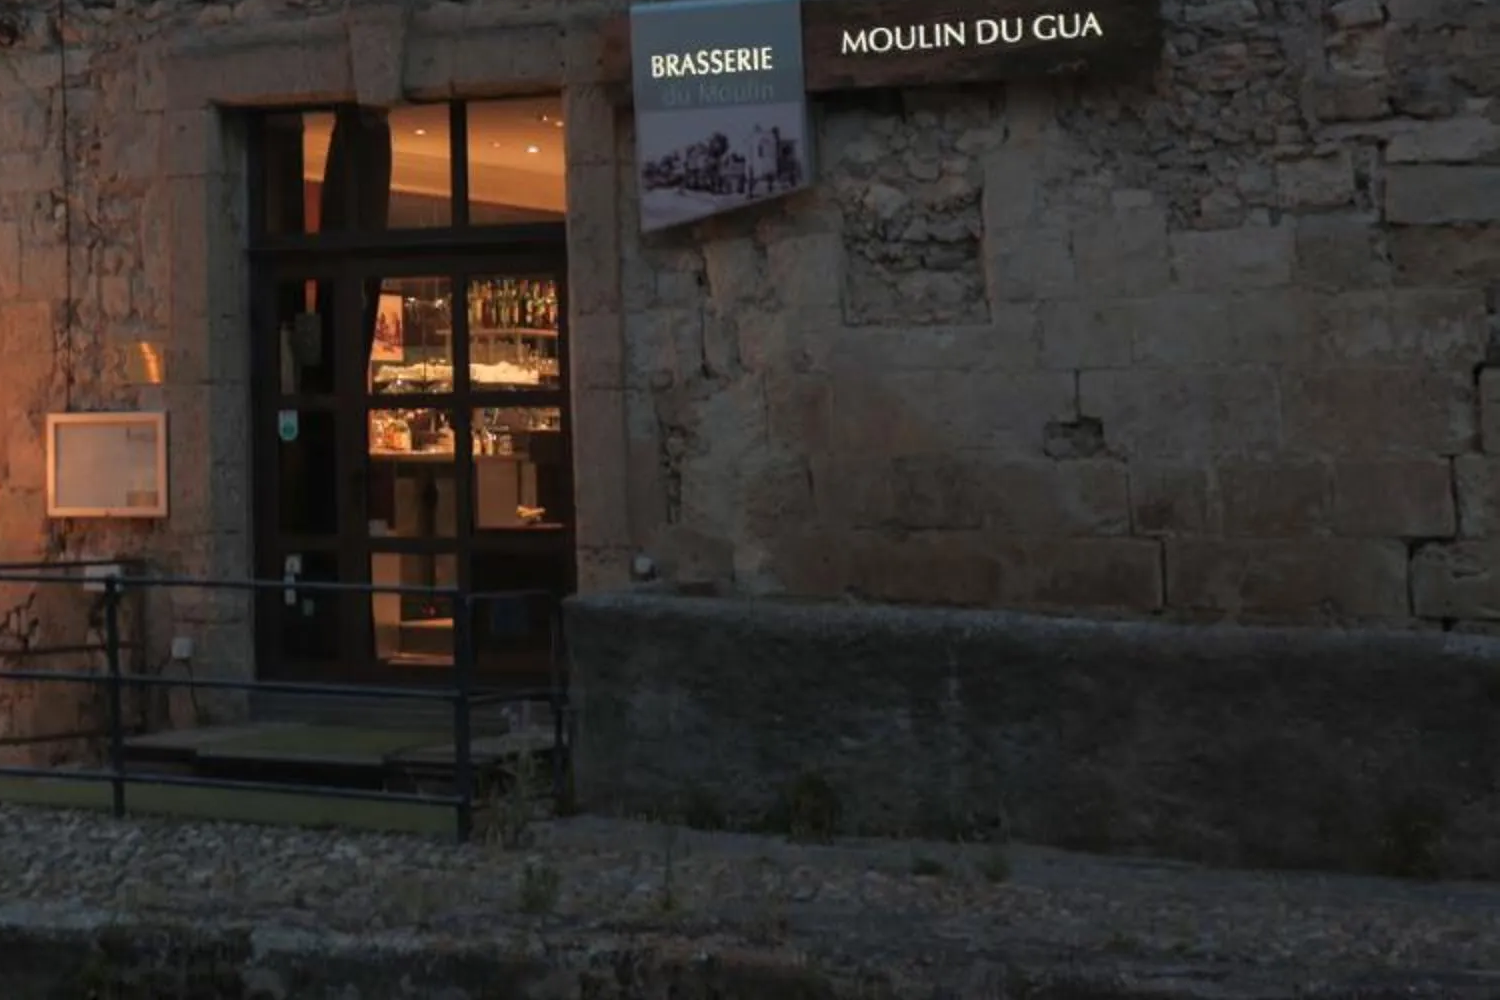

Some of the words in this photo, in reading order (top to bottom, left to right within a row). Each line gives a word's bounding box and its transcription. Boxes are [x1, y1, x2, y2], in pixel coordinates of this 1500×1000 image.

[841, 21, 966, 54] MOULIN
[975, 17, 1023, 45] DU
[1032, 11, 1103, 41] GUA
[651, 46, 773, 78] BRASSERIE
